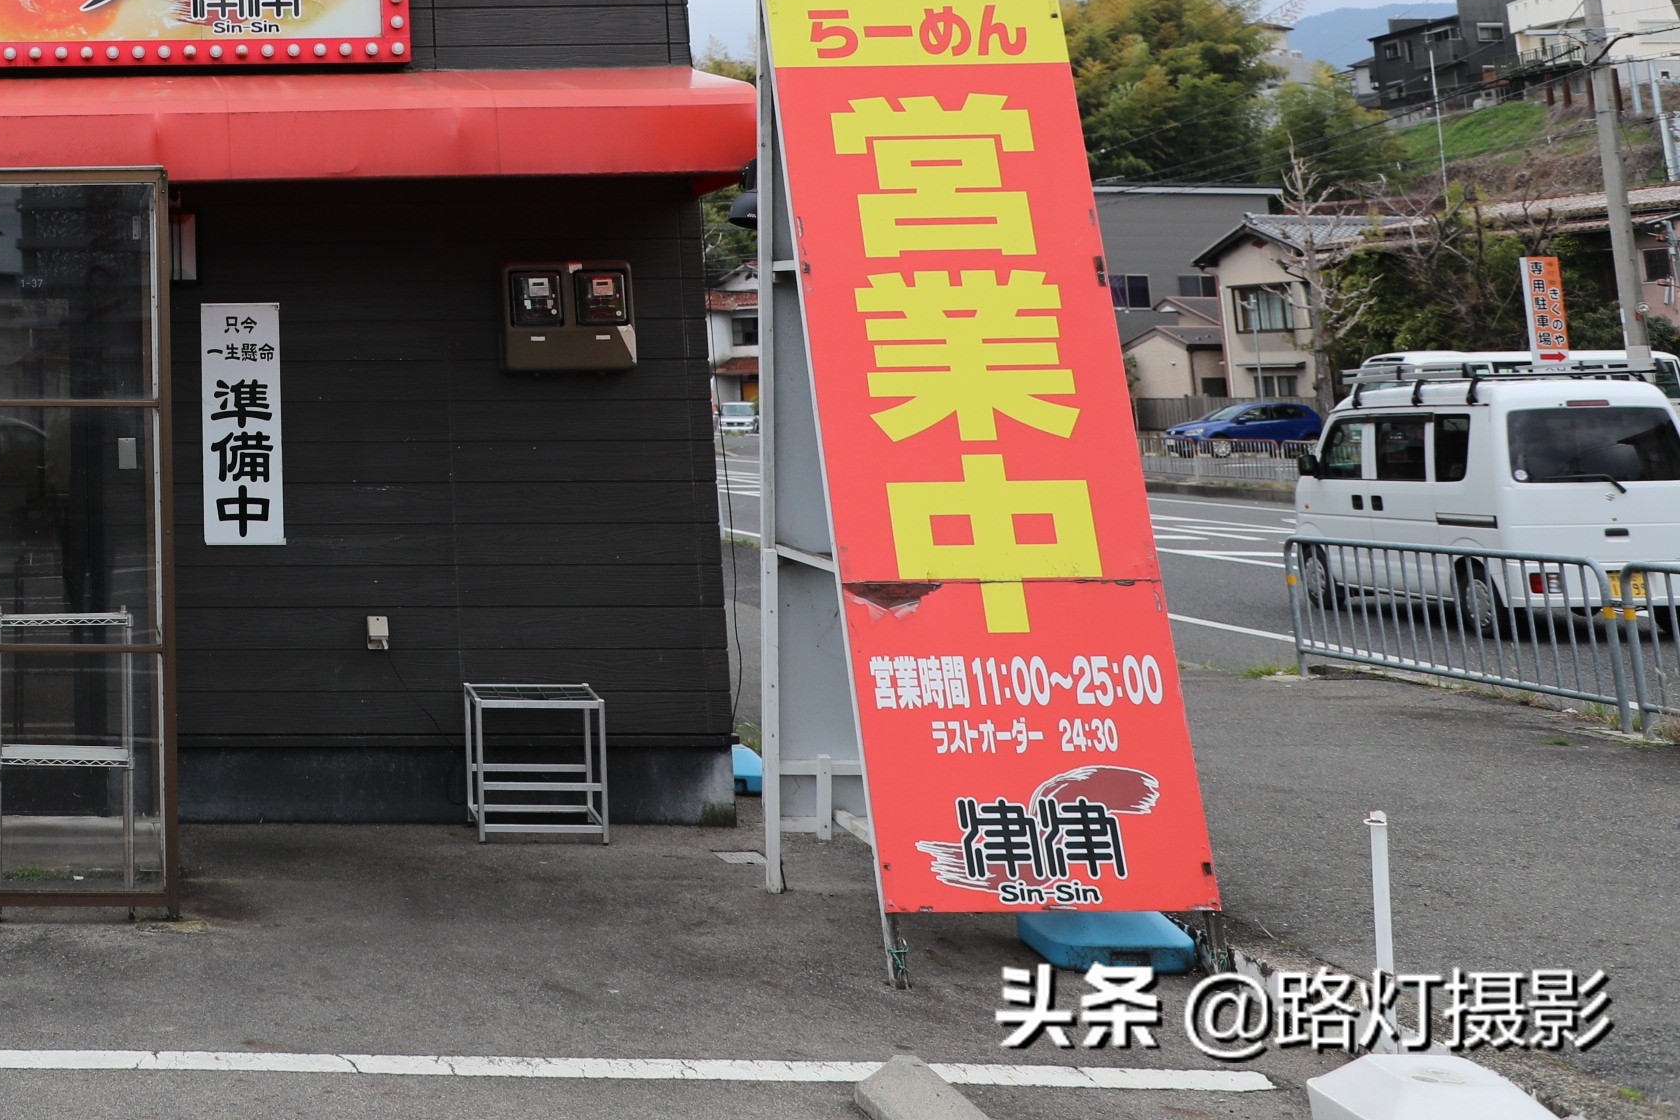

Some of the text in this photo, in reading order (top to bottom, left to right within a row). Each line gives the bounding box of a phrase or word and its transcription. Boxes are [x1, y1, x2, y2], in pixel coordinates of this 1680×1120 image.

[213, 20, 281, 34] Sin-Sin
[808, 5, 1026, 59] らーめん
[21, 279, 43, 288] 1-37
[1530, 261, 1552, 346] 専用駐車場
[224, 316, 257, 334] 只今
[1549, 288, 1565, 346] きくのや
[207, 343, 275, 362] 一生懸命
[830, 93, 1104, 633] 営業中
[211, 379, 274, 538] 準備中
[869, 656, 970, 709] 営業時間
[931, 717, 1118, 754] ラストオーダー 24:30
[955, 796, 1128, 880] 津津
[998, 881, 1103, 905] Sin-Sin
